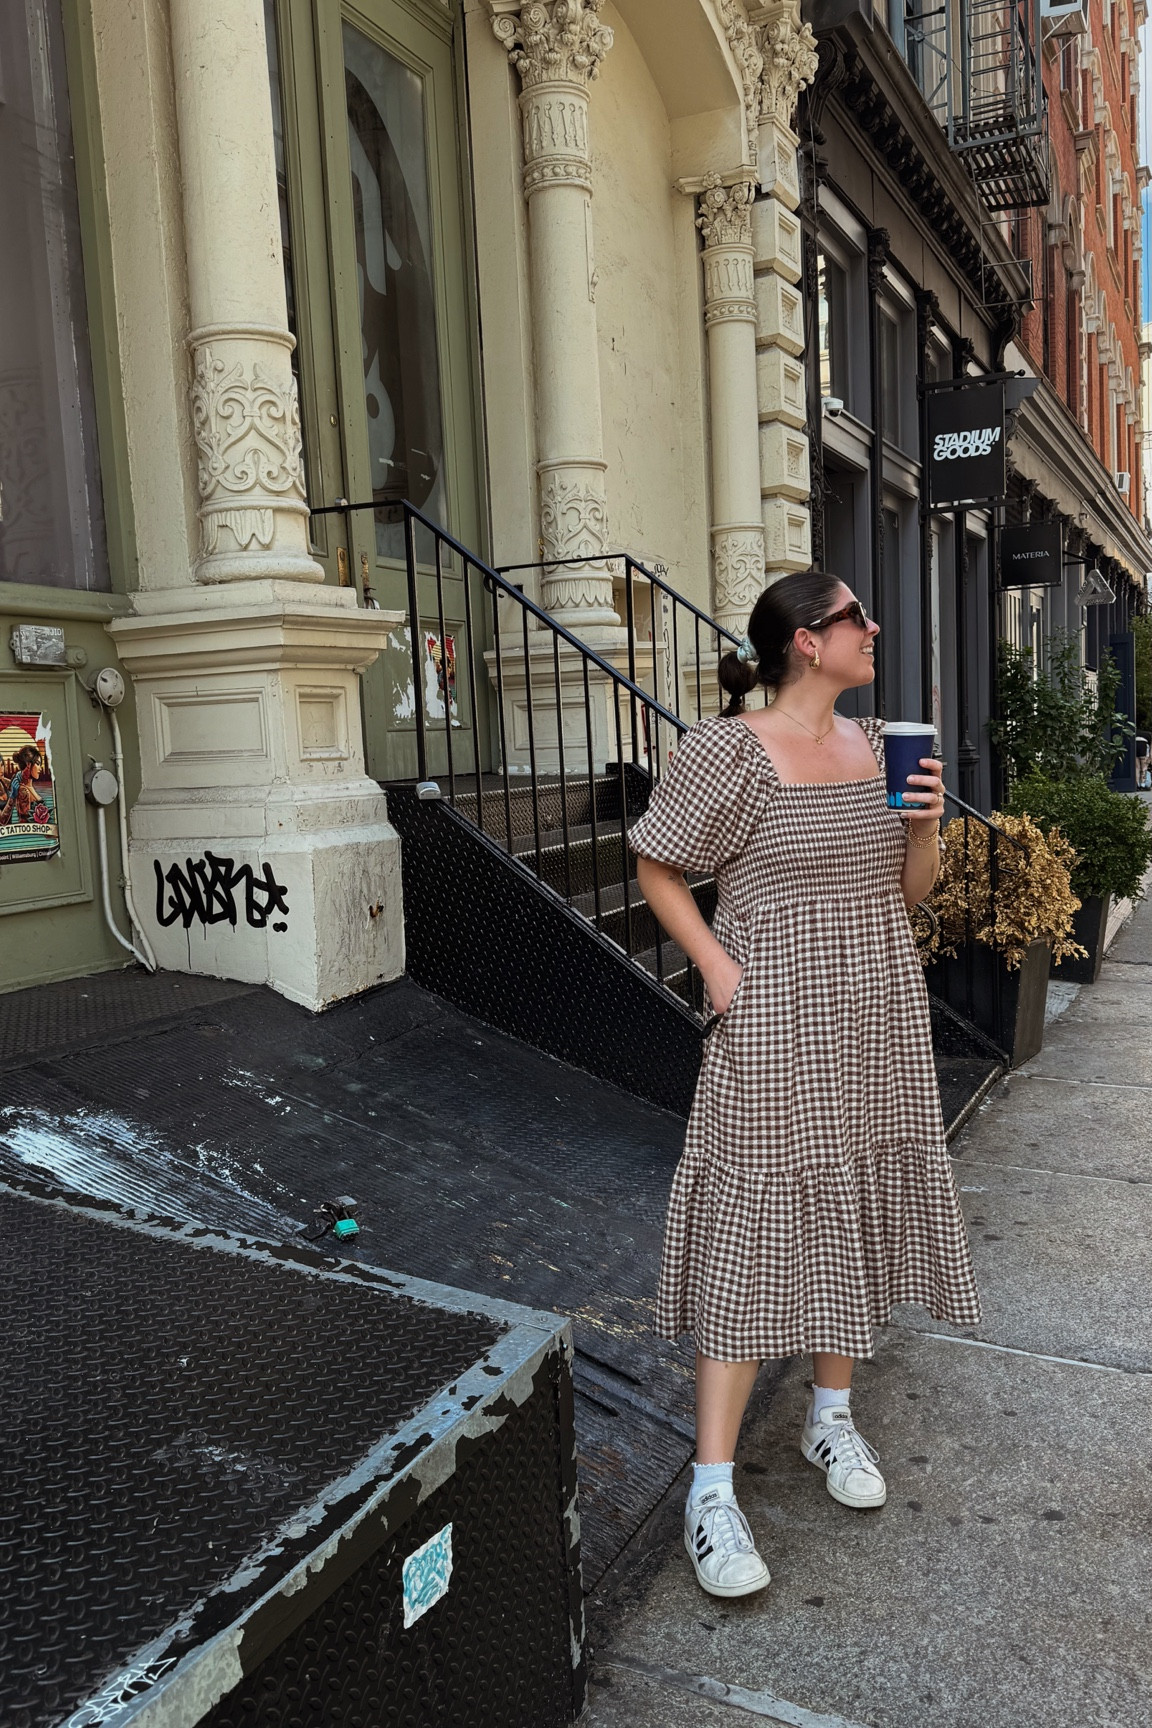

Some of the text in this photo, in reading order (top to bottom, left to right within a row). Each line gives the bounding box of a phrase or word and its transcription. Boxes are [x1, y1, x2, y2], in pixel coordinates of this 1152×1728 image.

[933, 426, 1001, 449] STADIUM
[933, 443, 992, 461] GOODS
[1012, 550, 1050, 560] MATERIA
[6, 825, 31, 834] TATTOO
[32, 824, 51, 834] SHOP
